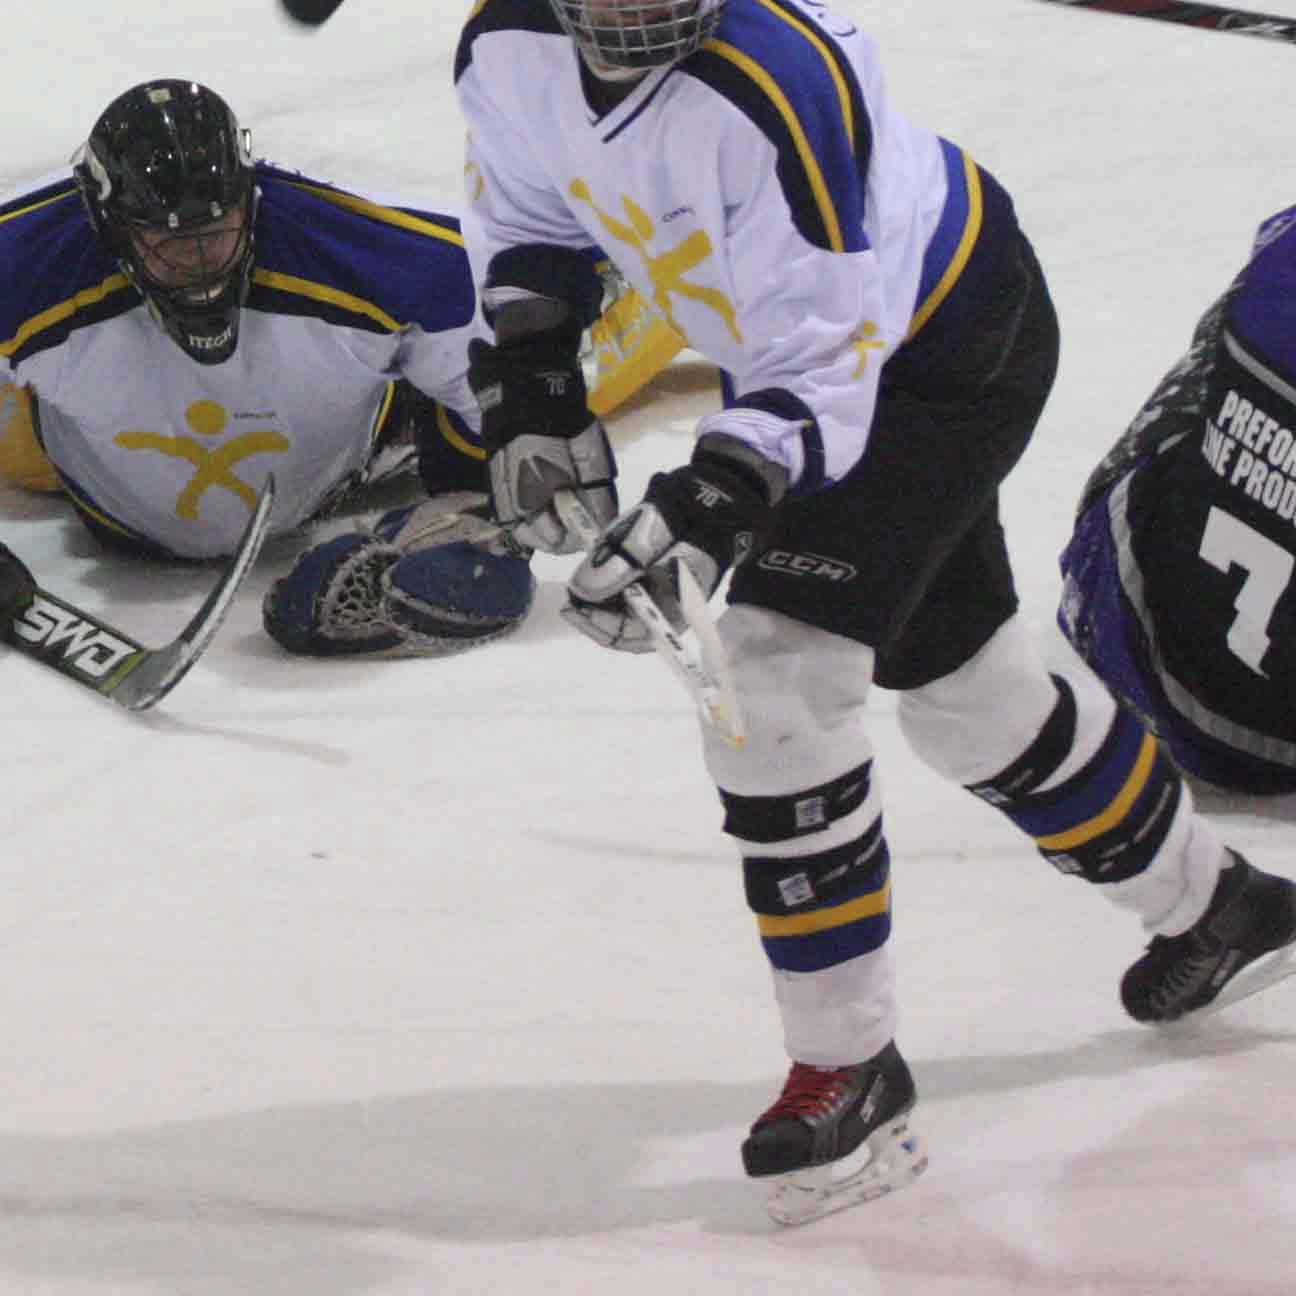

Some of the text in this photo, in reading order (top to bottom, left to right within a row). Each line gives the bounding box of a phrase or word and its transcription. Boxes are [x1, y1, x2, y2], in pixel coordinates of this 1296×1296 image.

[1231, 448, 1296, 528] PROD
[767, 551, 850, 583] CCM
[1198, 504, 1296, 680] 7
